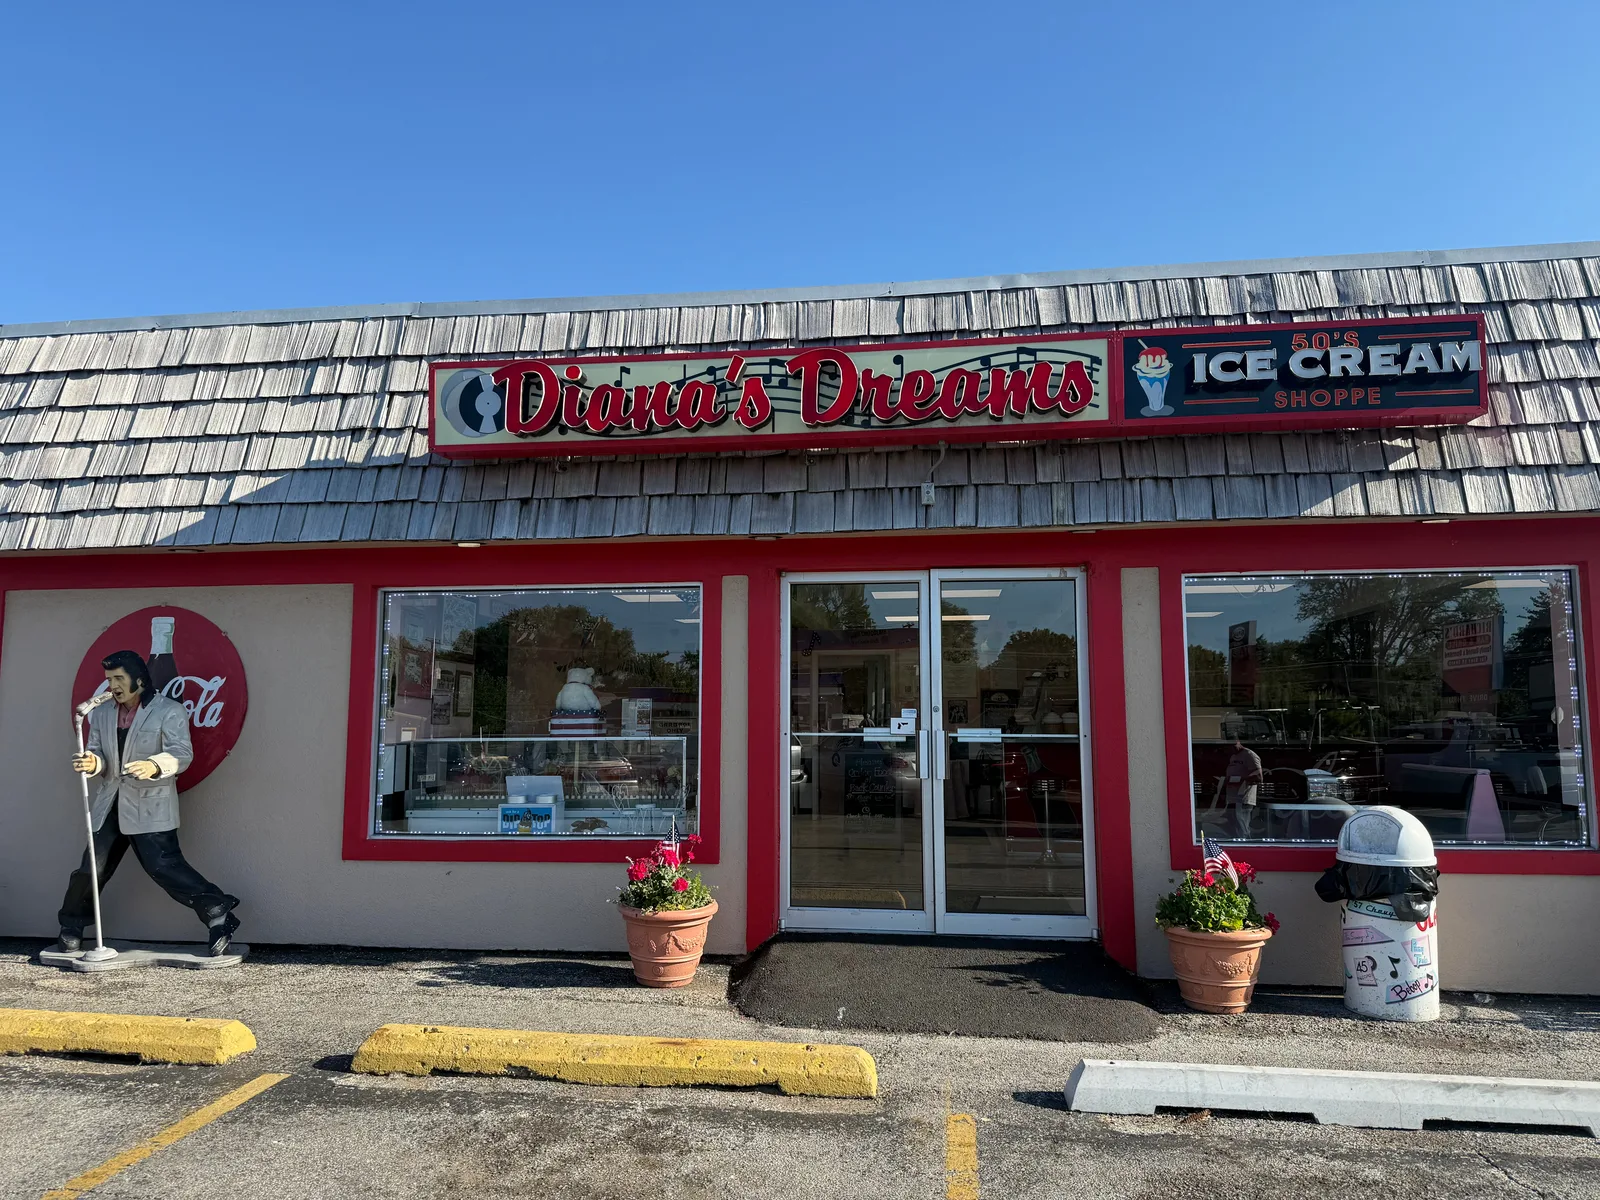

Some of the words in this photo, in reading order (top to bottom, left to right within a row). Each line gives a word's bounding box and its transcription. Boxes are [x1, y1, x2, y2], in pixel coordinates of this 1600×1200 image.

[1291, 332, 1360, 351] 50'S
[1193, 349, 1278, 384] ICE
[1288, 340, 1484, 380] CREAM
[492, 353, 772, 436] Diana's
[786, 347, 1095, 428] Dreams
[1274, 387, 1382, 409] SHOPPE
[1356, 960, 1368, 973] 45
[1390, 979, 1423, 1001] Bebop
